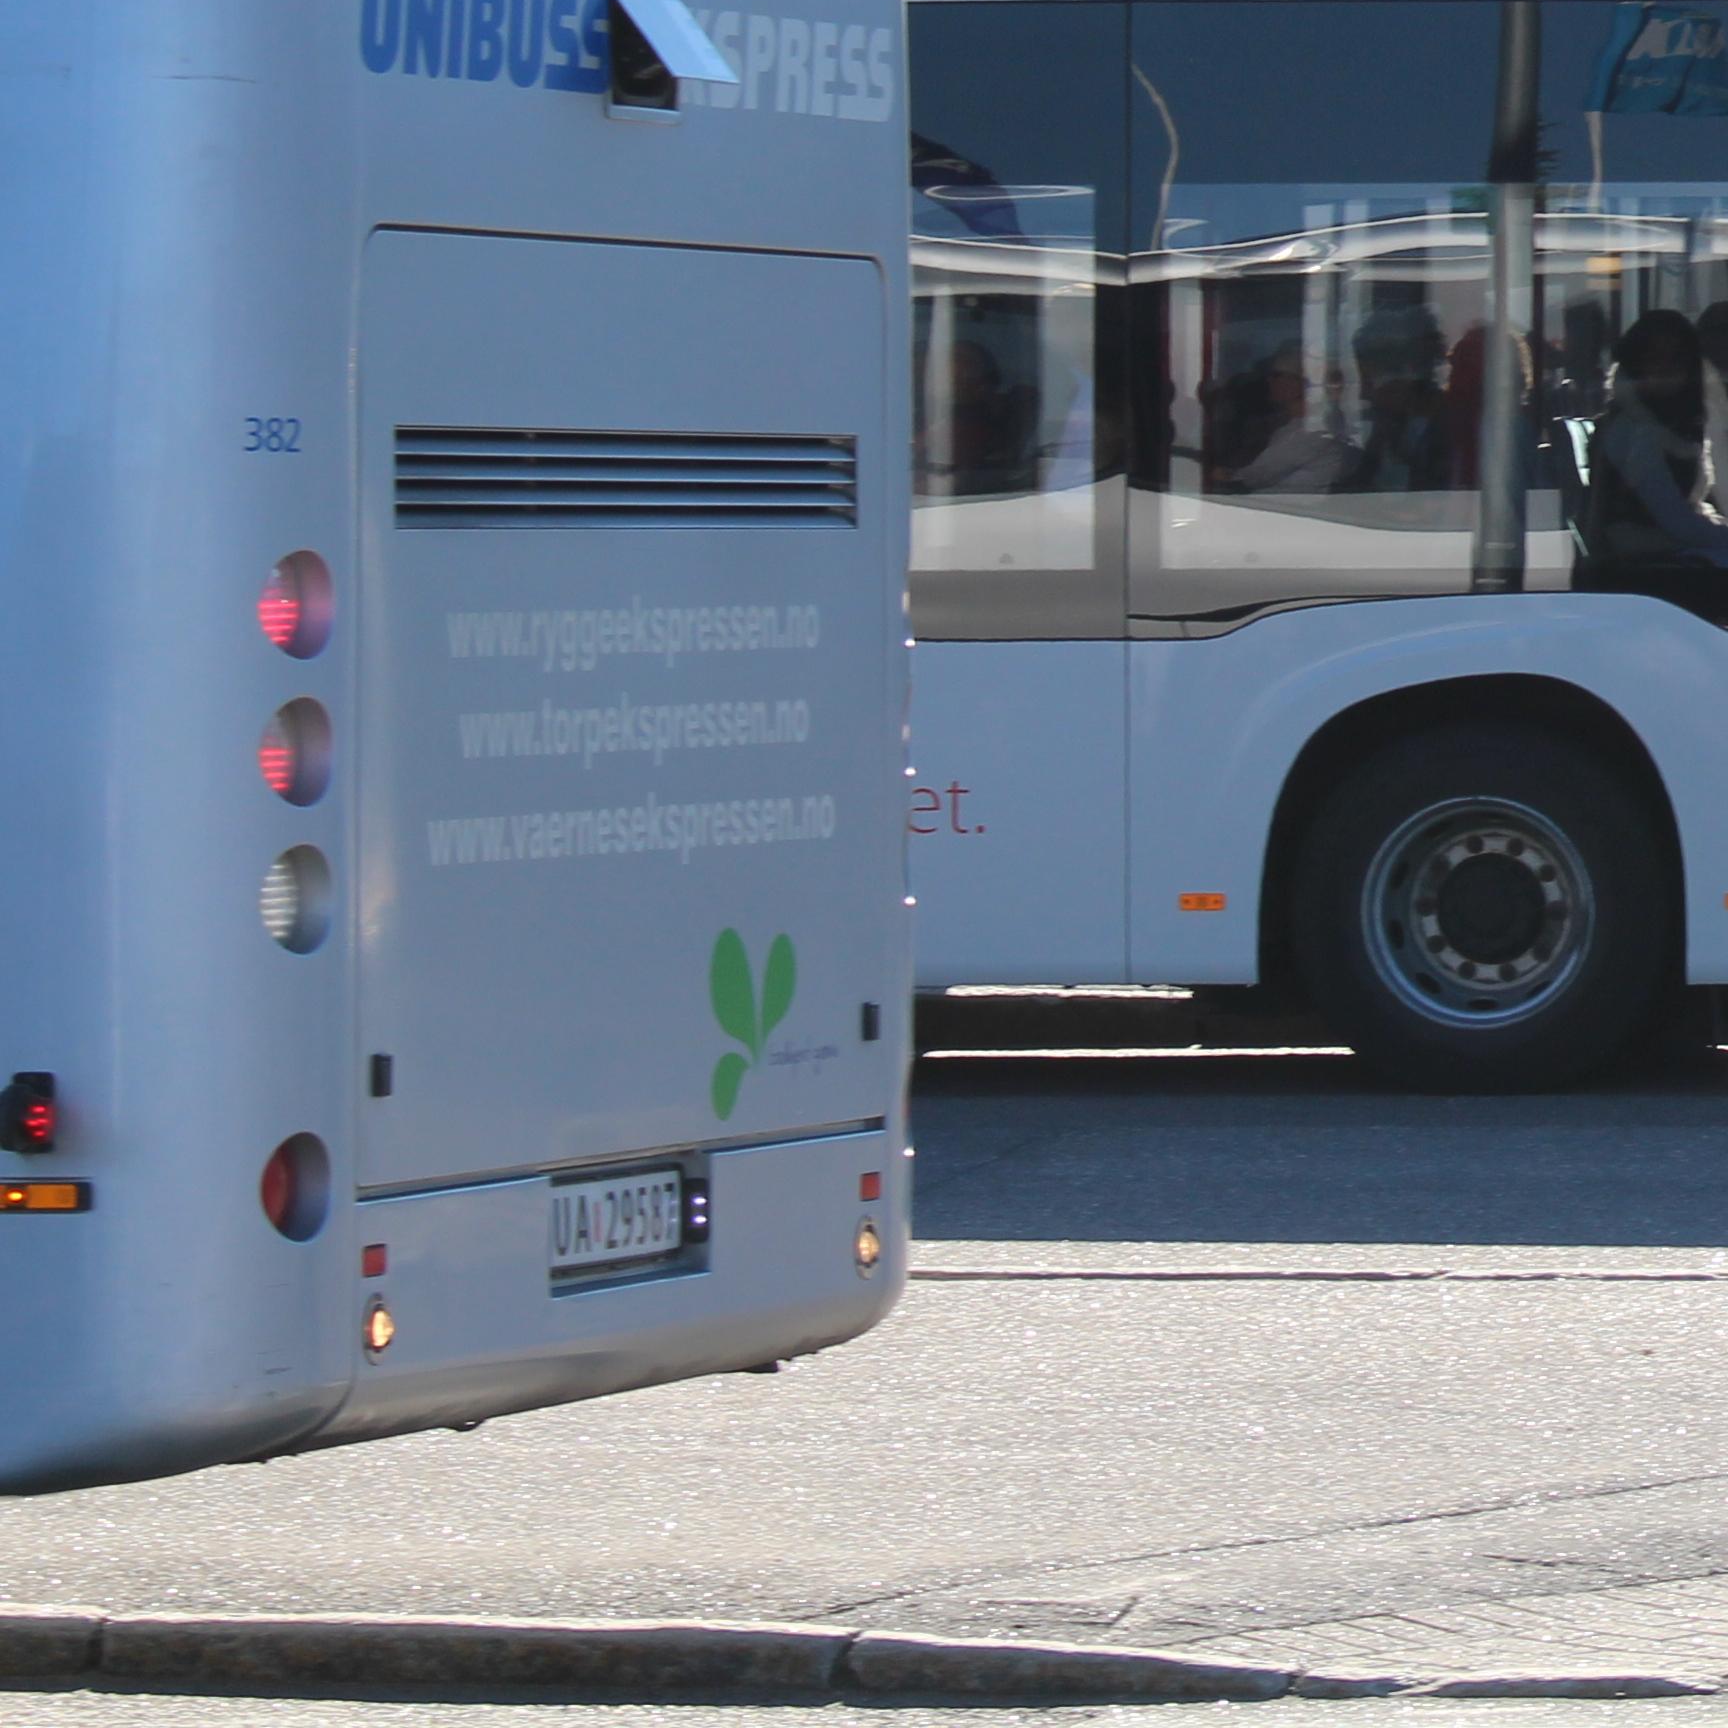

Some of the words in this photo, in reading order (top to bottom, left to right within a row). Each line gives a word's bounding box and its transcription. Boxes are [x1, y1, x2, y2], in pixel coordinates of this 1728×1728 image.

[680, 9, 897, 122] SPRESS
[243, 417, 302, 452] 382
[446, 594, 821, 673] www.ryggeekspressen.no
[459, 690, 810, 770] www.torpekspressen.no
[427, 791, 836, 866] www.vaernesekspressen.no
[551, 1194, 591, 1257] UA
